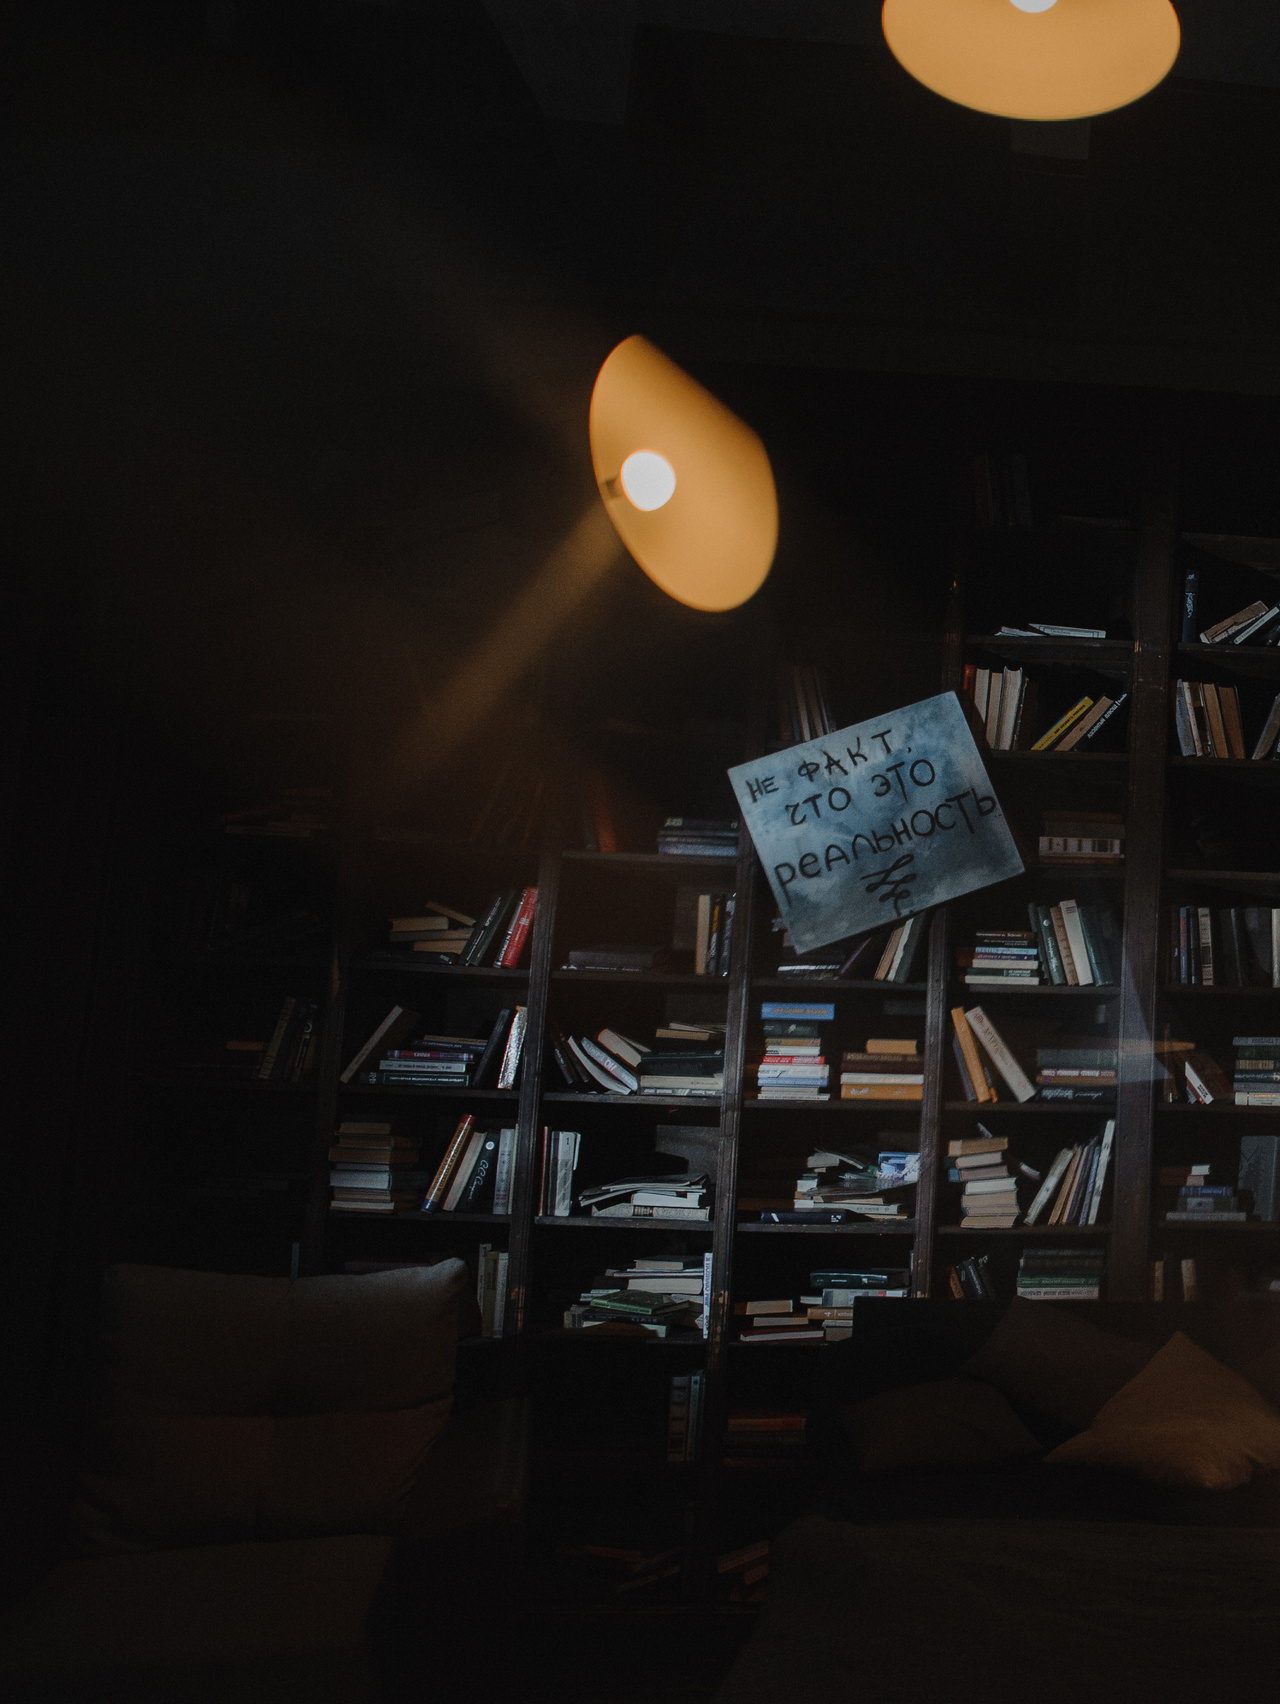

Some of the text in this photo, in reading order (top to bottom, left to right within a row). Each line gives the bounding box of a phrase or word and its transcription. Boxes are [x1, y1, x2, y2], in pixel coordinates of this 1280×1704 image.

[745, 775, 780, 804] НЕ
[784, 758, 936, 827] ЧТО ЭТО
